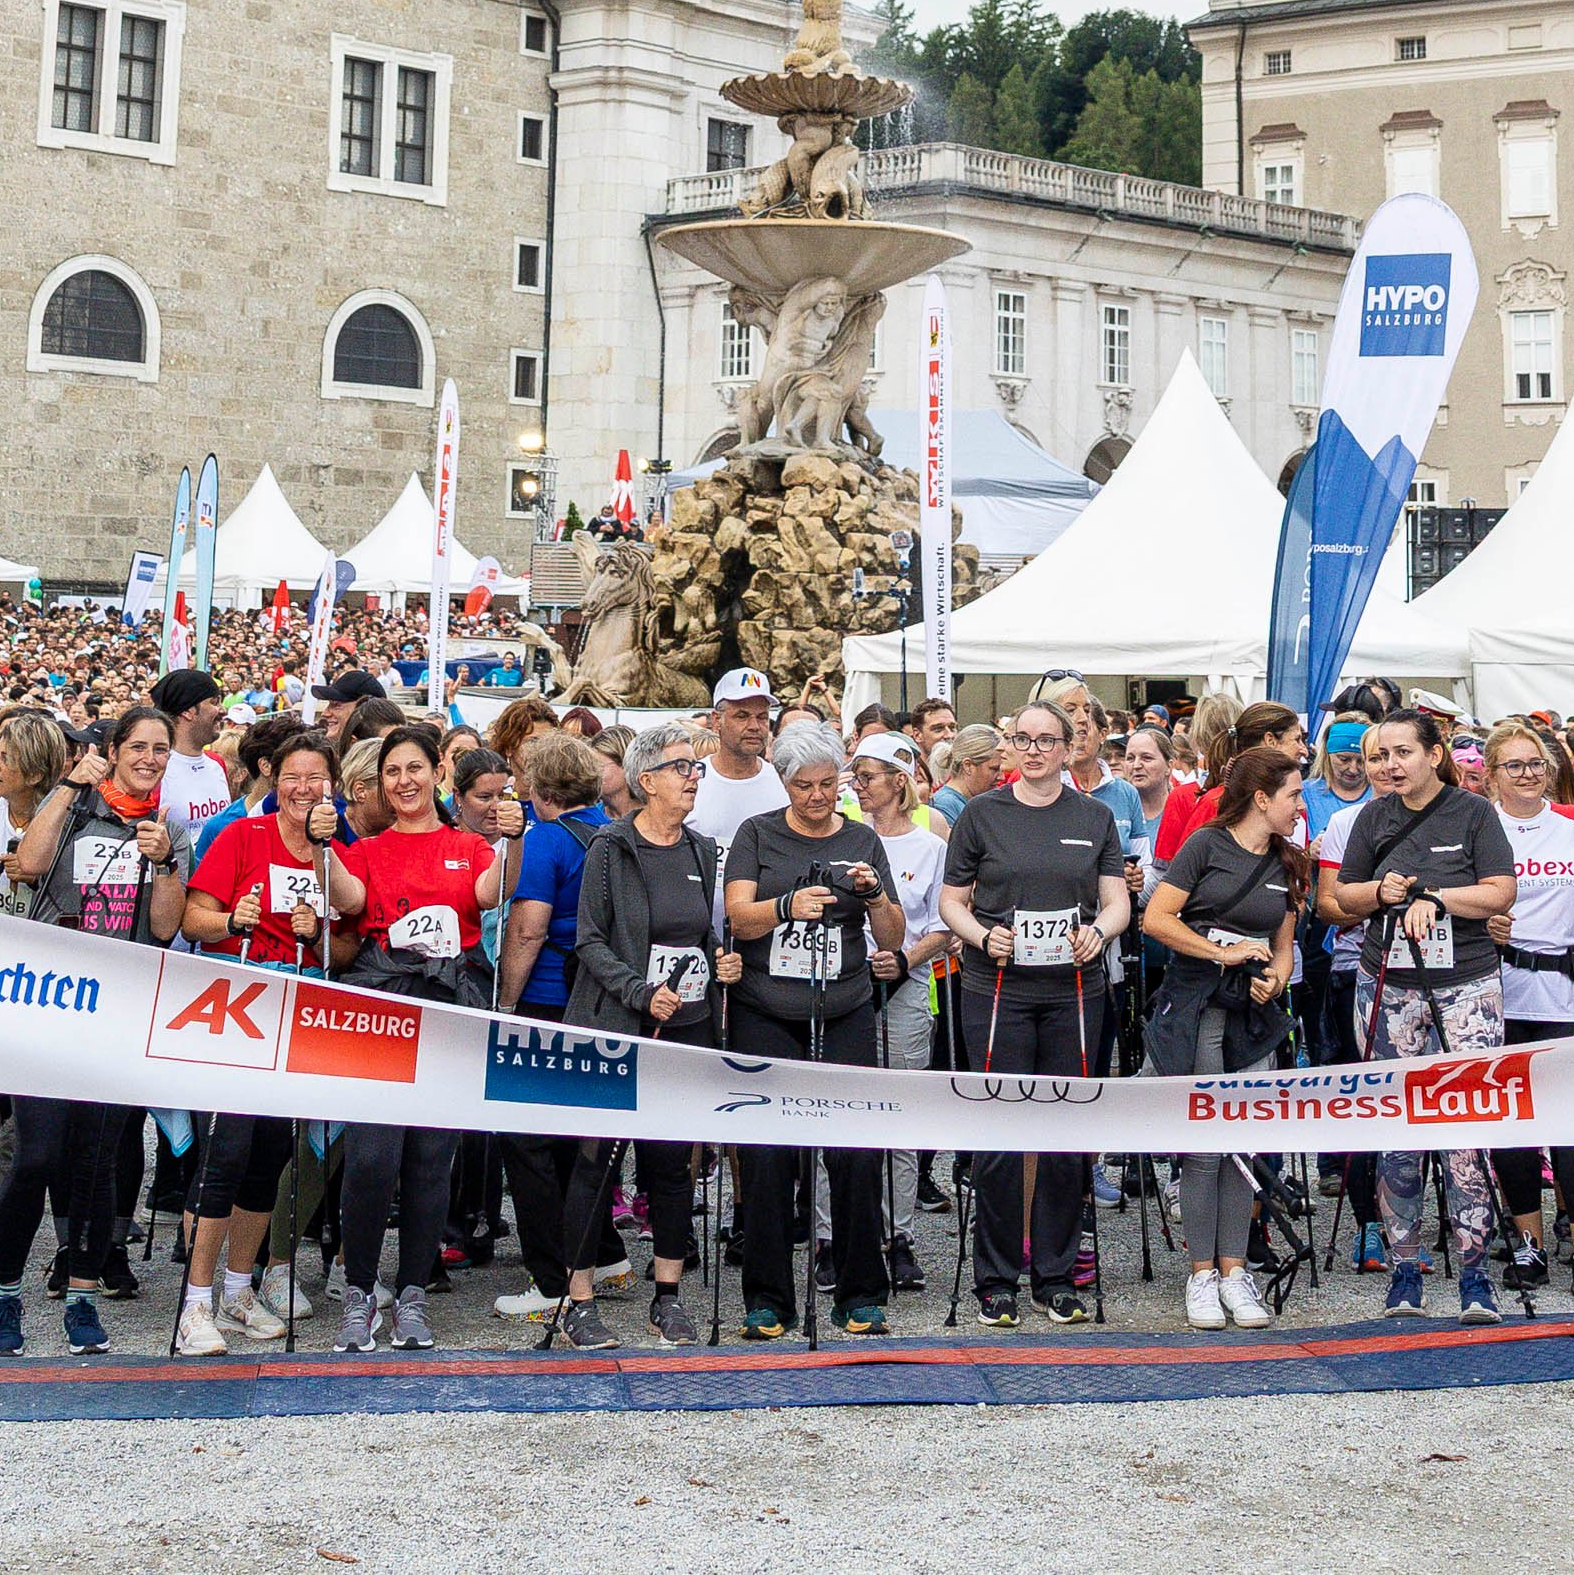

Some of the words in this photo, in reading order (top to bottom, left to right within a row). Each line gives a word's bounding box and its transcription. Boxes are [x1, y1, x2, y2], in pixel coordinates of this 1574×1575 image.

[1366, 284, 1446, 312] HYPO
[1365, 313, 1443, 327] SALZBURG
[928, 367, 939, 504] WKS
[937, 620, 946, 663] starke
[937, 667, 946, 695] eine
[189, 797, 230, 821] hobe
[1514, 858, 1574, 877] obex
[407, 915, 443, 938] 22A
[166, 978, 269, 1040] AK
[299, 1005, 416, 1039] SALZBURG
[496, 1050, 629, 1077] SALZBURG
[781, 1096, 903, 1113] PORSCHE
[781, 1109, 830, 1119] BANK
